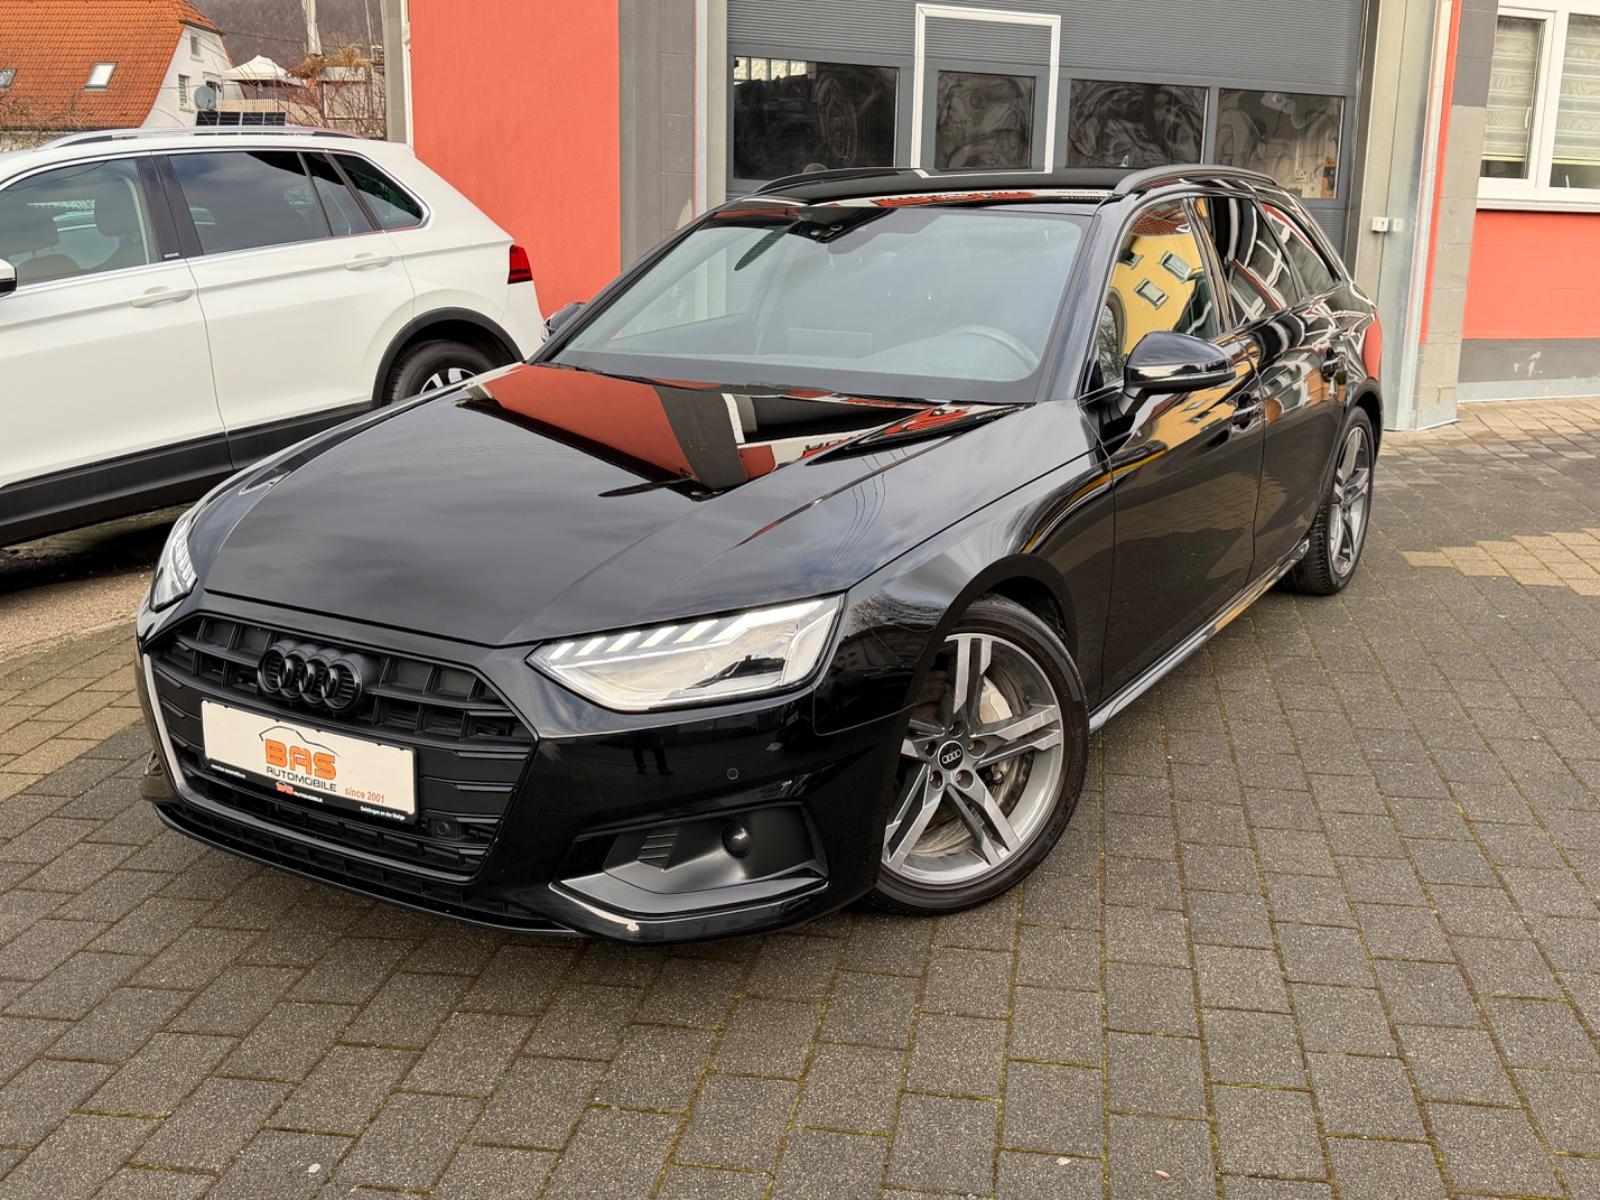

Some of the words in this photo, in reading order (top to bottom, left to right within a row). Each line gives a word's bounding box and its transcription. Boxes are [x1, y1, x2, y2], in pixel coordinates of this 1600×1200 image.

[265, 738, 336, 780] BAS
[266, 766, 337, 792] AUTOMOBILE
[345, 786, 365, 800] since
[367, 791, 385, 804] 2001
